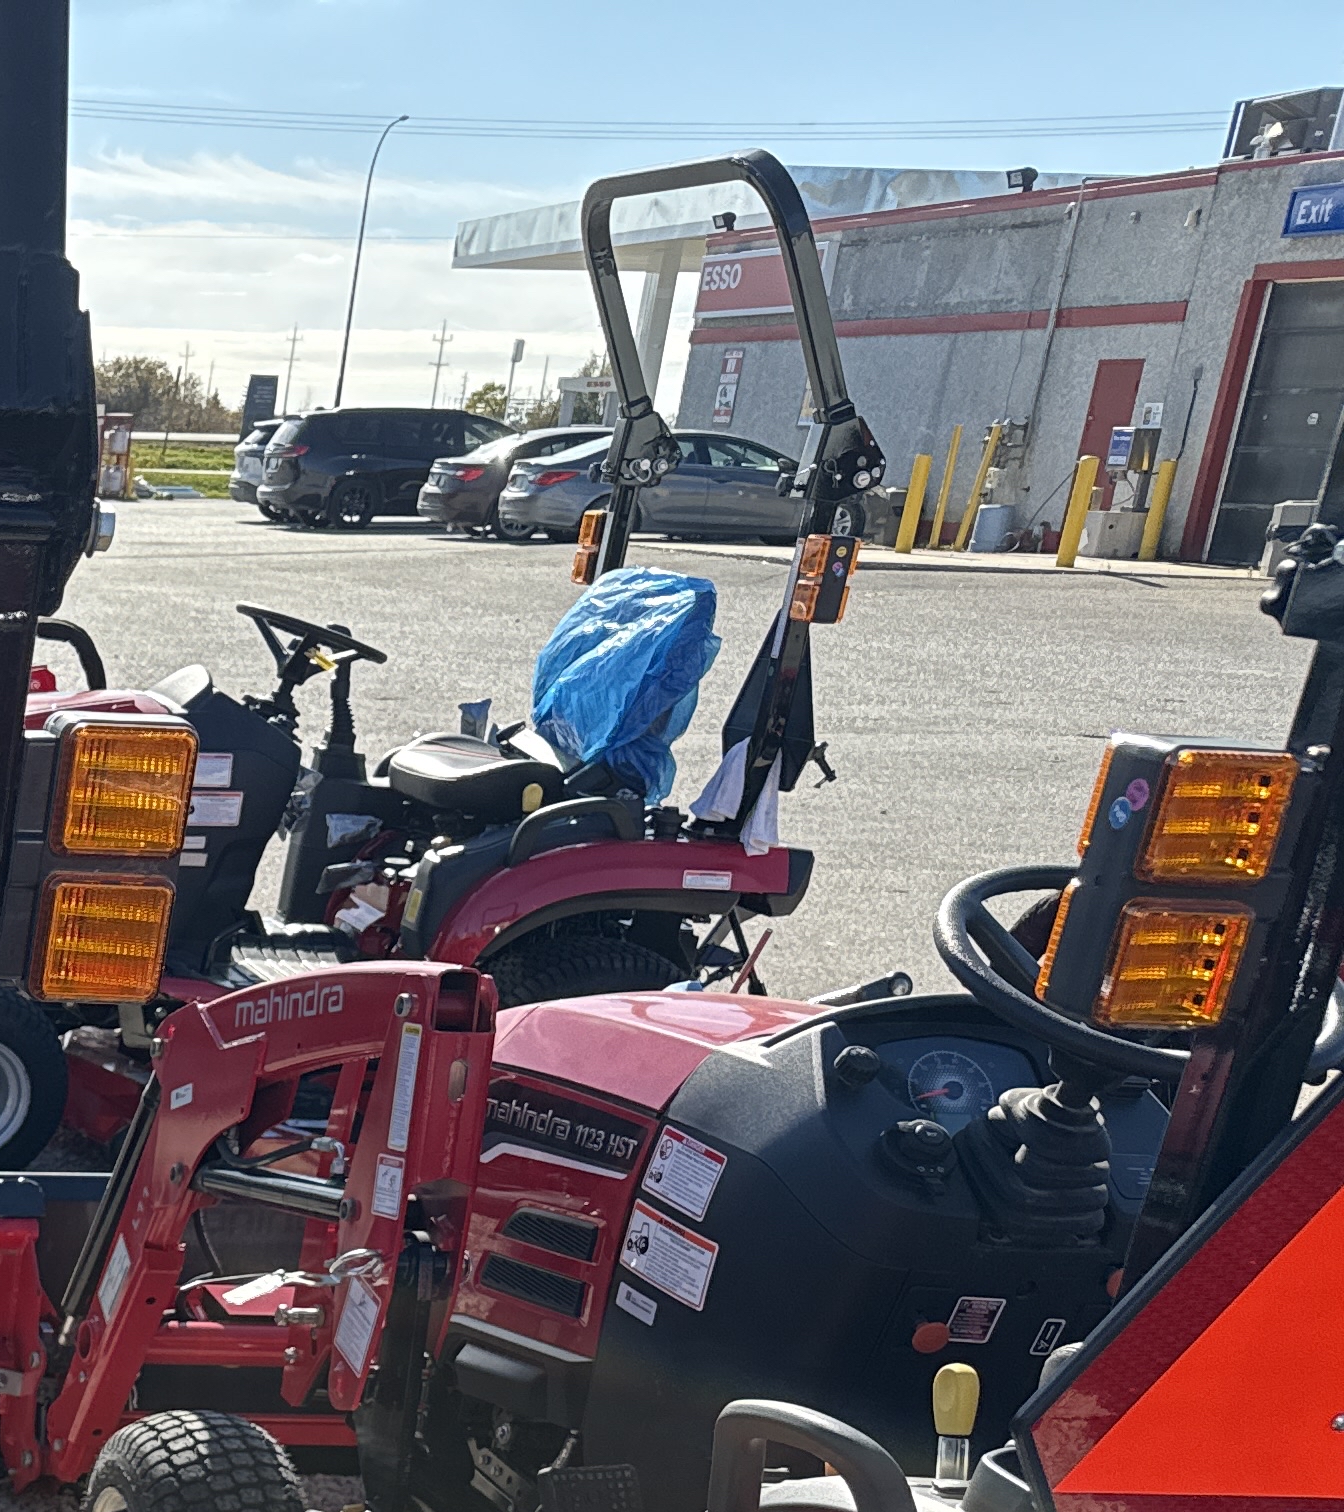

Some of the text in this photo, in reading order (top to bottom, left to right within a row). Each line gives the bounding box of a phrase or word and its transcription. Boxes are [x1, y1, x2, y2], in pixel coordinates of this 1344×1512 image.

[1295, 196, 1334, 226] Exit
[701, 263, 743, 292] ESSO
[234, 981, 345, 1028] mahindra
[606, 1133, 639, 1160] HST
